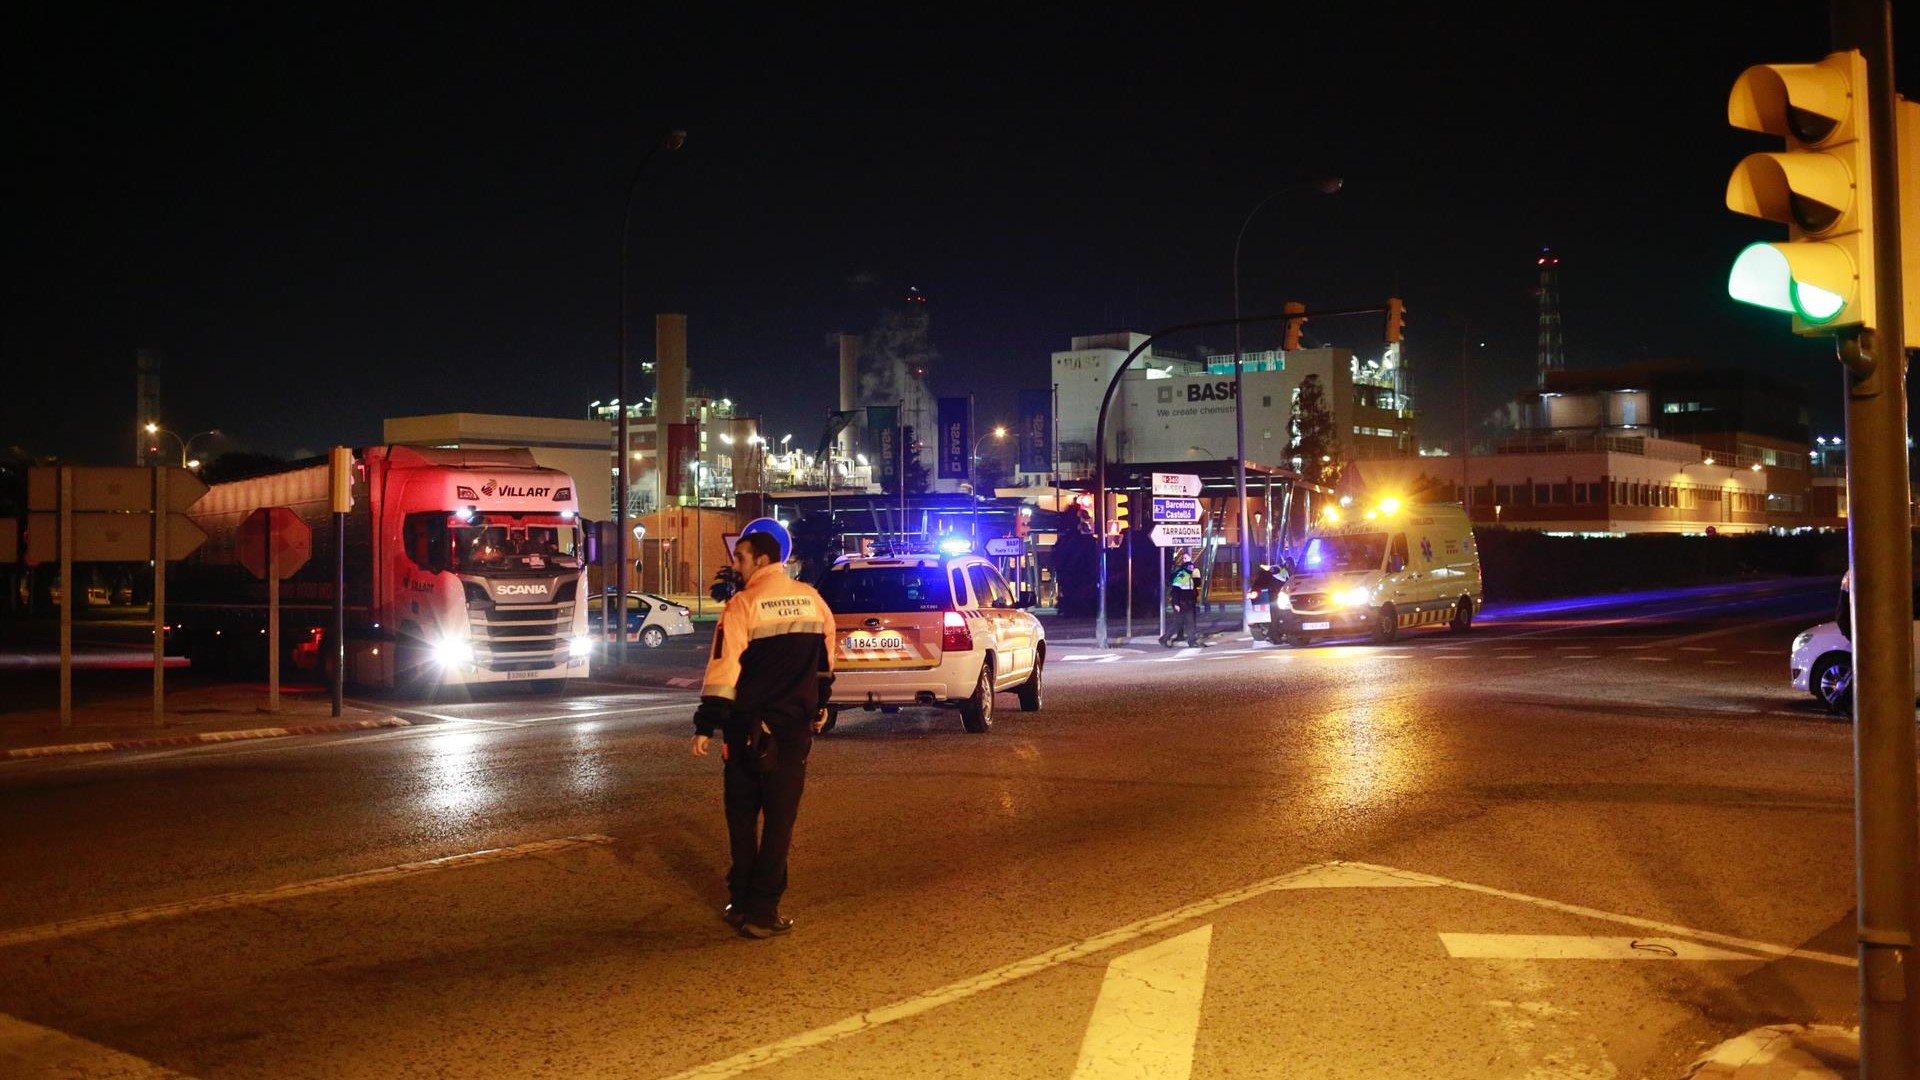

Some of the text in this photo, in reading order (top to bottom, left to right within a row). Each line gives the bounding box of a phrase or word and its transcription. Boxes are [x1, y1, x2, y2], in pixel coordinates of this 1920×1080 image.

[1157, 403, 1236, 417] We create chemistr
[498, 485, 550, 497] VILLART
[1165, 500, 1195, 509] Barcelona
[1166, 510, 1192, 519] Castelló
[1162, 527, 1200, 535] TARRAGONA
[497, 584, 548, 595] SCANIA
[853, 637, 900, 649] 1845 GDD
